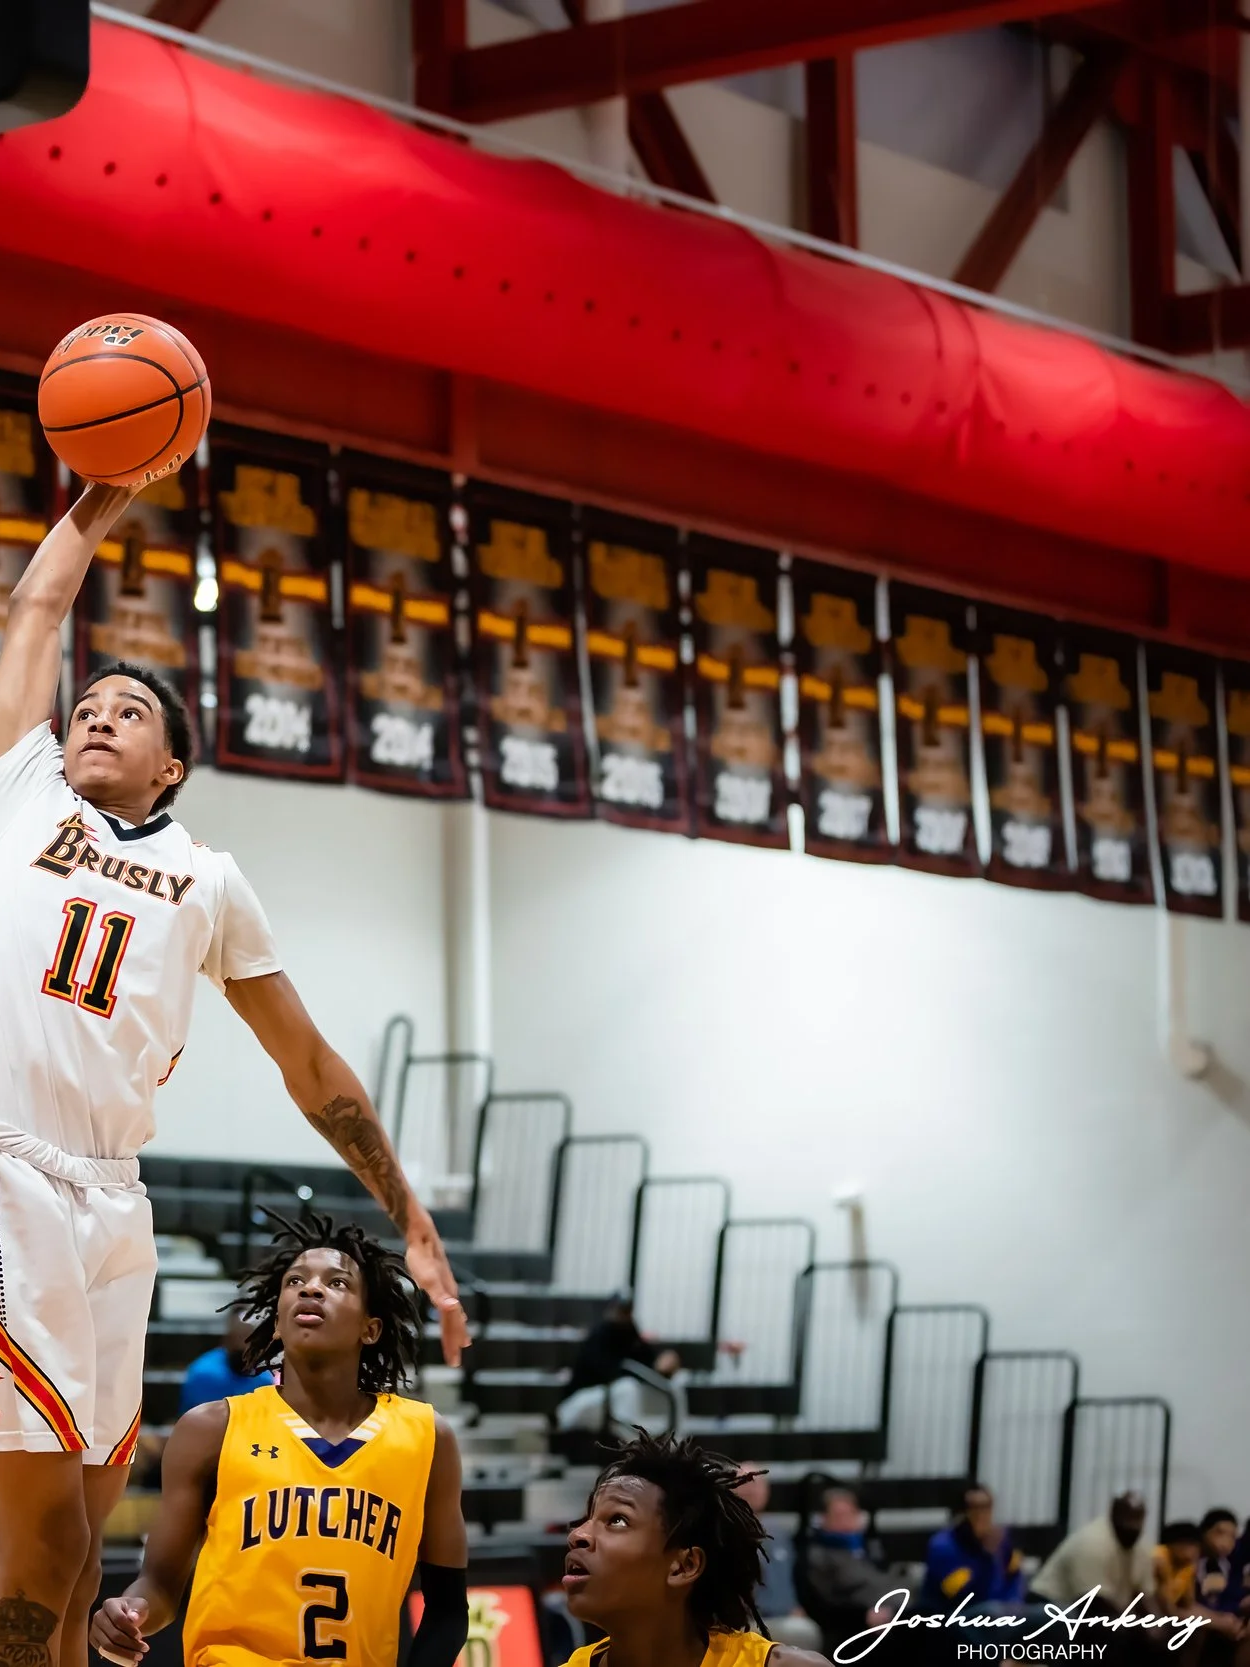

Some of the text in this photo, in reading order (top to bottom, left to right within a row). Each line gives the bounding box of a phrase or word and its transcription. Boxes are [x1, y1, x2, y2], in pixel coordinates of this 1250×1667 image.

[30, 814, 195, 906] BRUSLY
[41, 897, 136, 1020] 11
[240, 1486, 403, 1561] LUTCHER
[299, 1567, 352, 1662] 2
